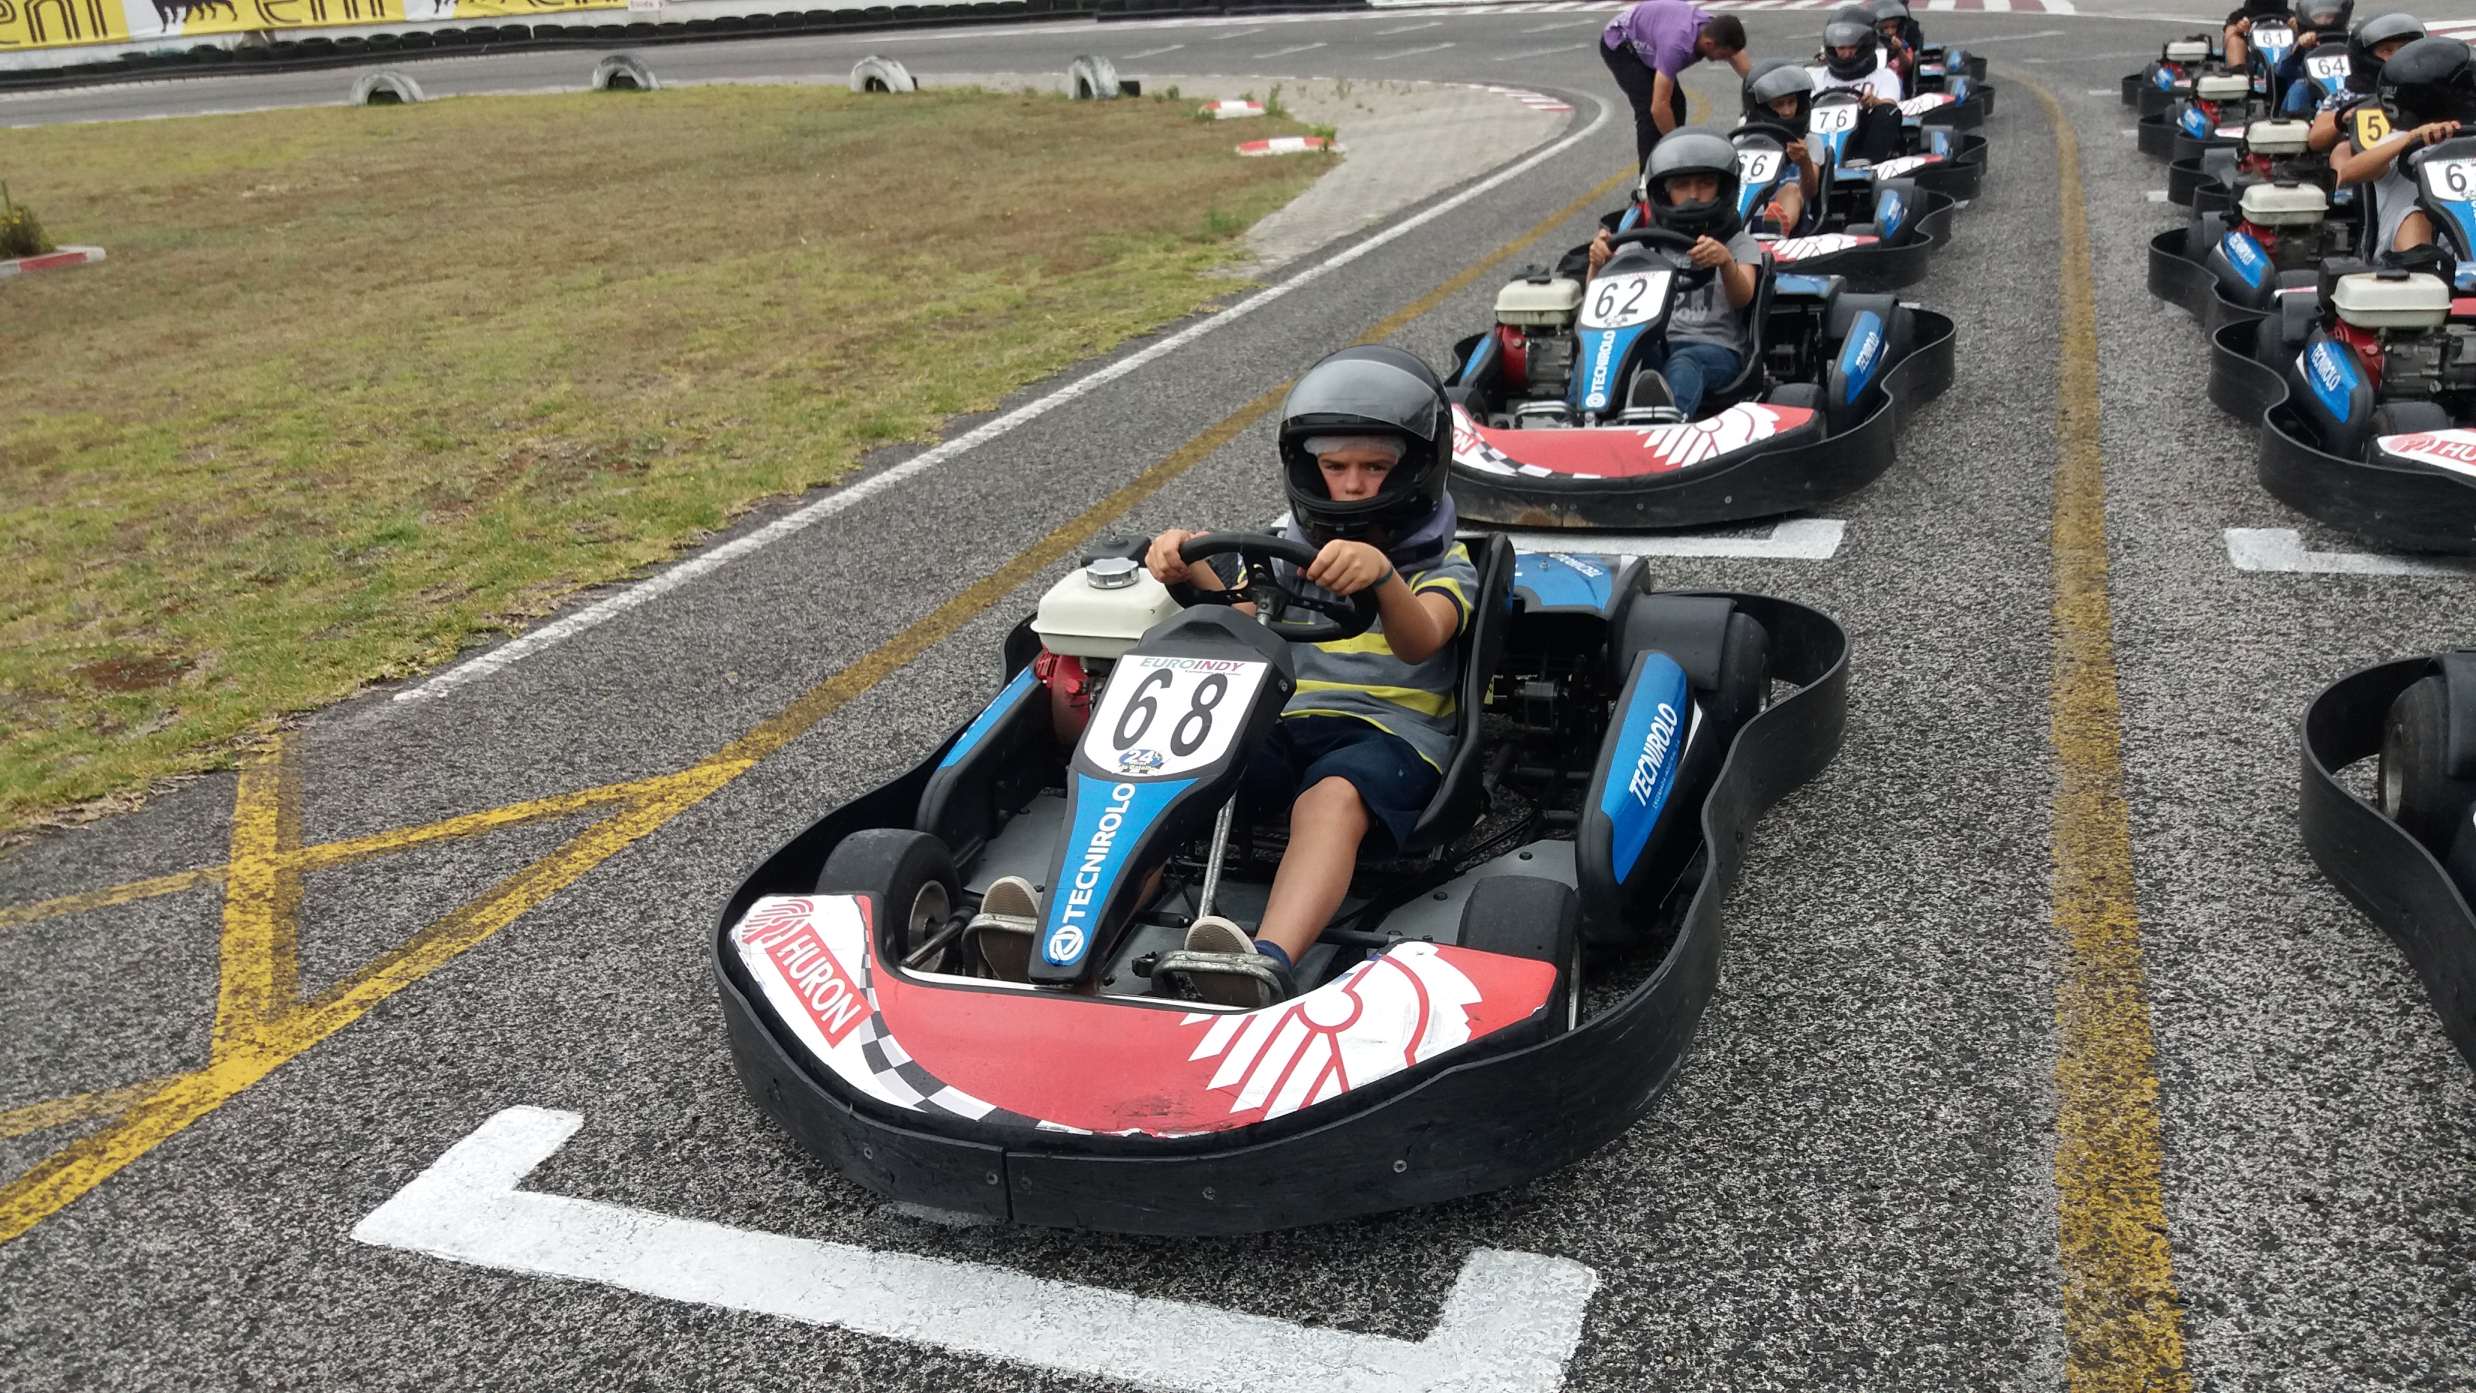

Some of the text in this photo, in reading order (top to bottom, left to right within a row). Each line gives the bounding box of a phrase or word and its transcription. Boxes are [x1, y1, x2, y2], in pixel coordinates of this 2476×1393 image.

[2317, 58, 2345, 75] 64
[1818, 109, 1849, 129] 76
[2367, 115, 2382, 142] 5
[2444, 162, 2476, 193] 6
[1594, 278, 1648, 320] 62
[1140, 656, 1247, 672] EUROINDY
[1112, 667, 1229, 758] 68
[1628, 702, 1678, 807] TECNIROLO
[1062, 782, 1136, 924] TECNIROLO
[776, 934, 862, 1035] HURON
